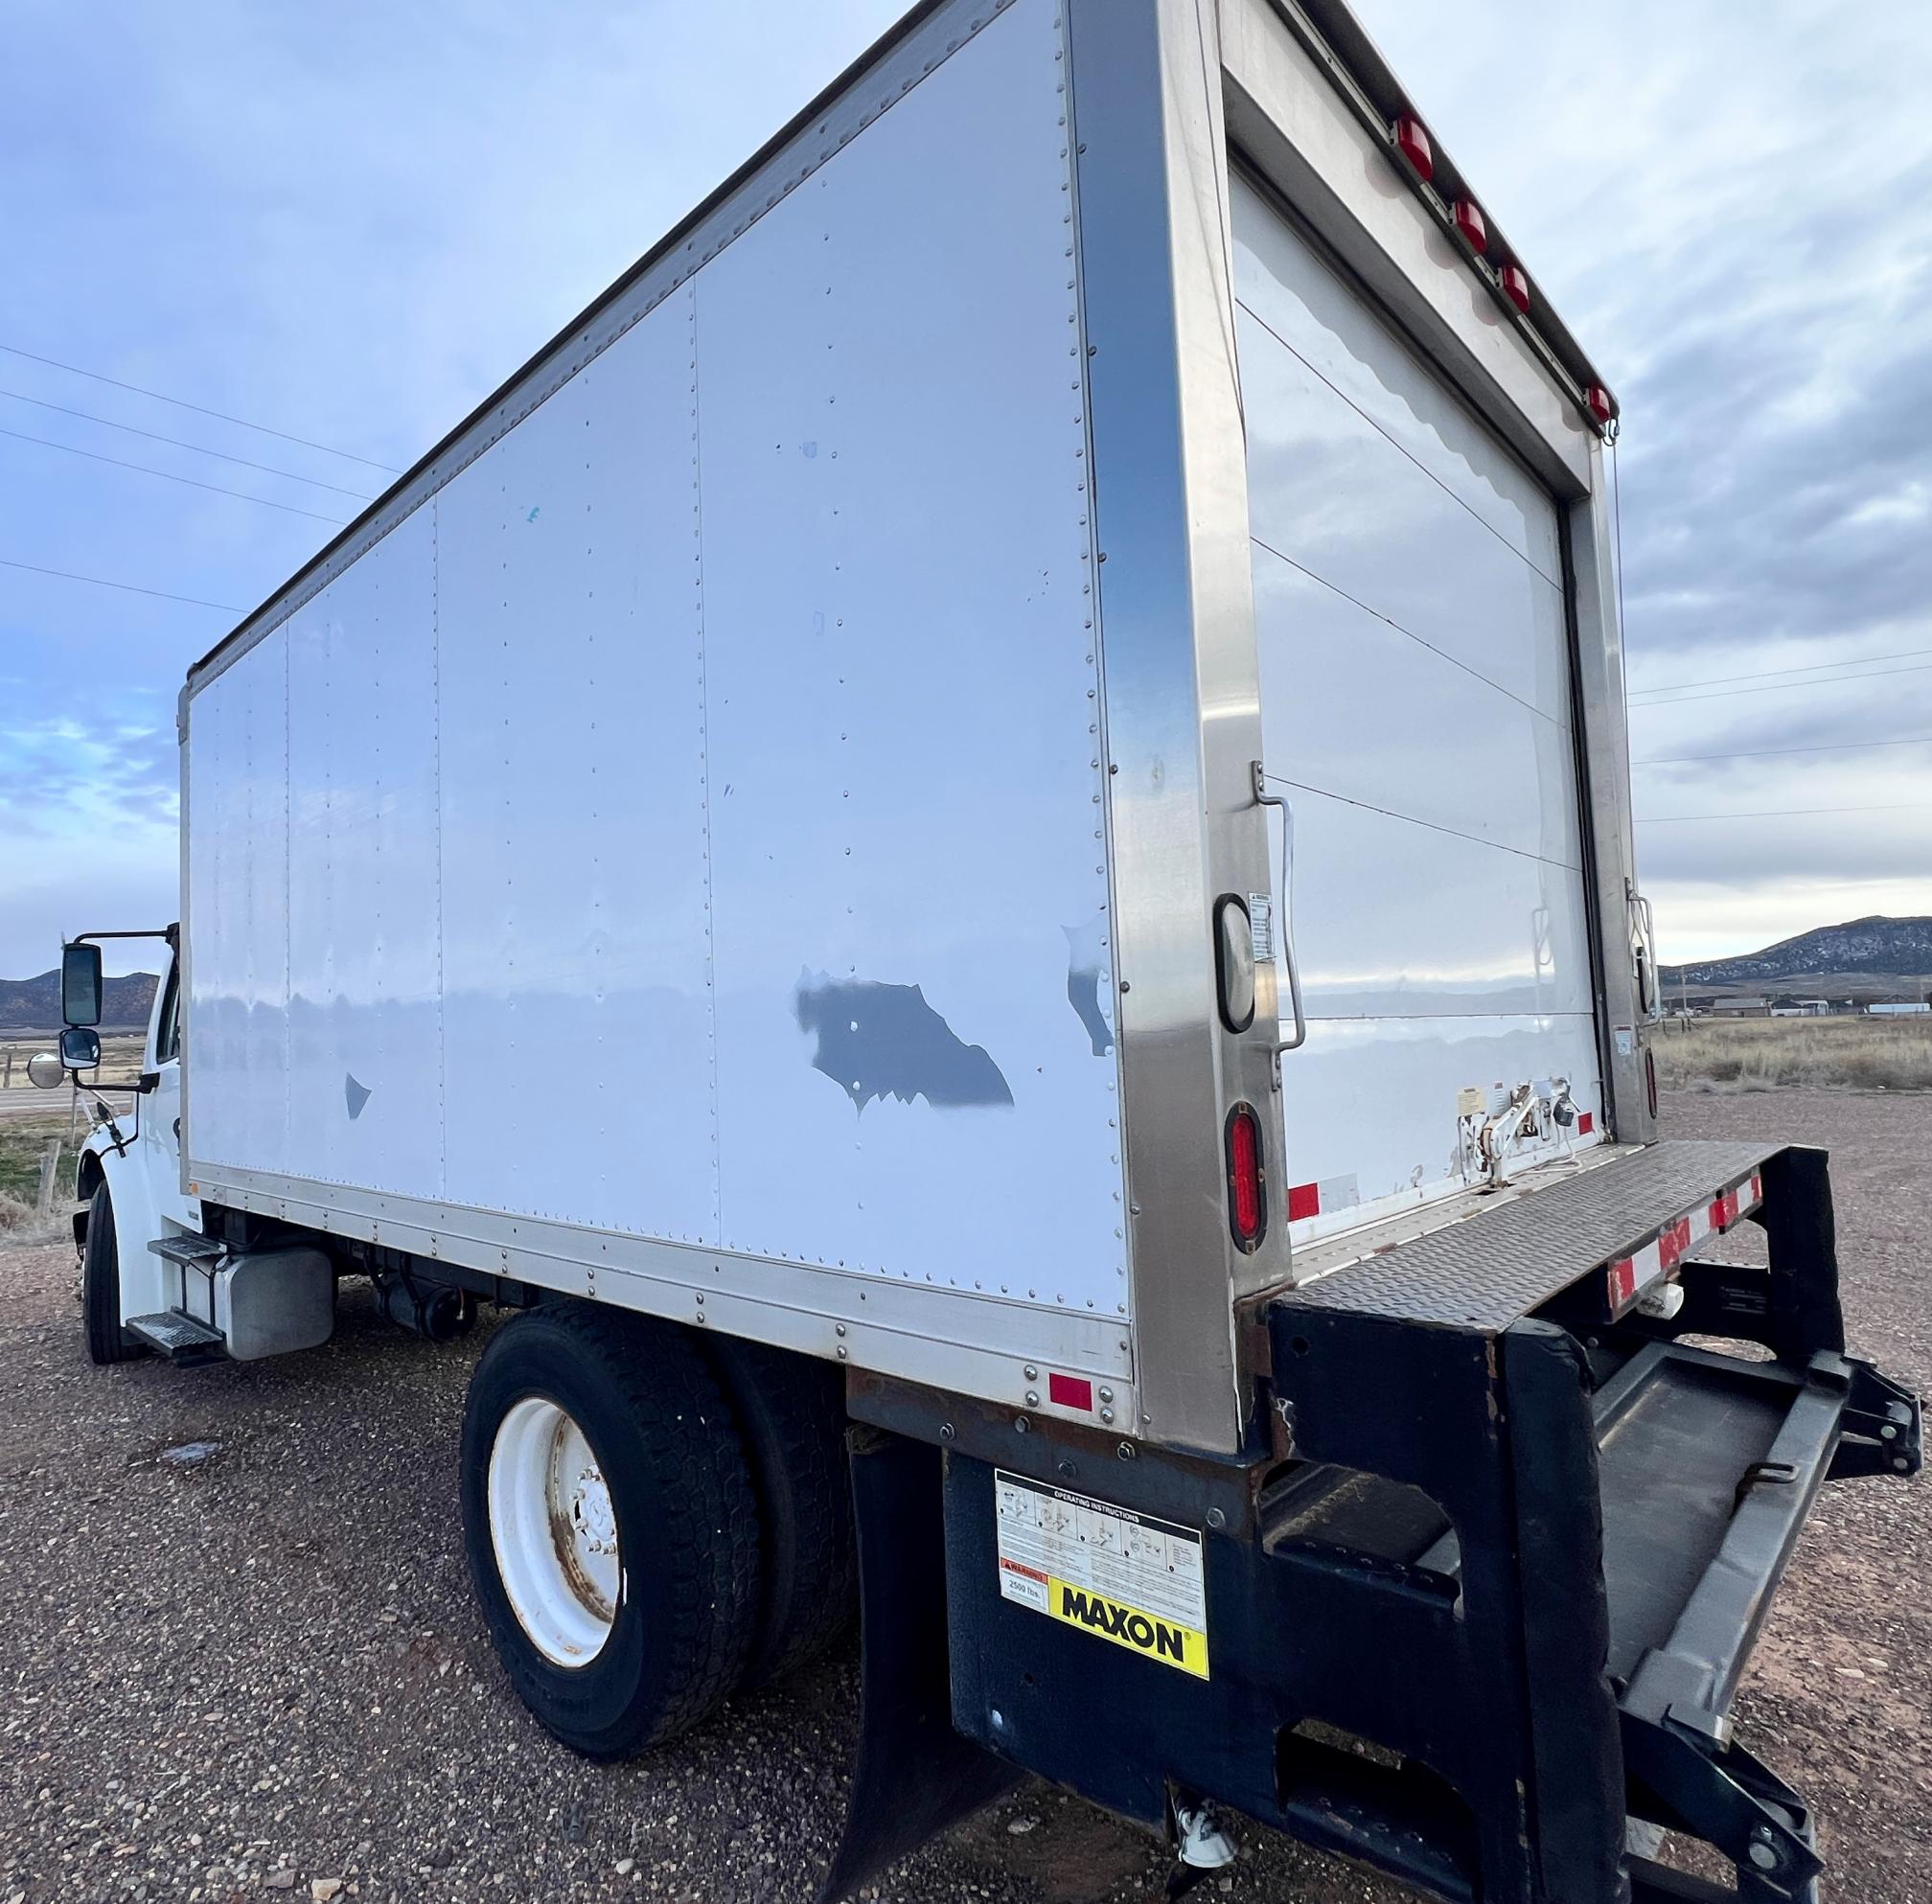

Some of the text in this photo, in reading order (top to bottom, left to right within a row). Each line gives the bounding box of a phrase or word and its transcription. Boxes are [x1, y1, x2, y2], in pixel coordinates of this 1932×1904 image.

[1054, 1490, 1090, 1508] OPERATING
[1091, 1502, 1139, 1523] INSTRUCTIONS
[1010, 1563, 1043, 1581] WARNING
[1009, 1579, 1026, 1593] 2500
[1062, 1587, 1184, 1663] MAXON
